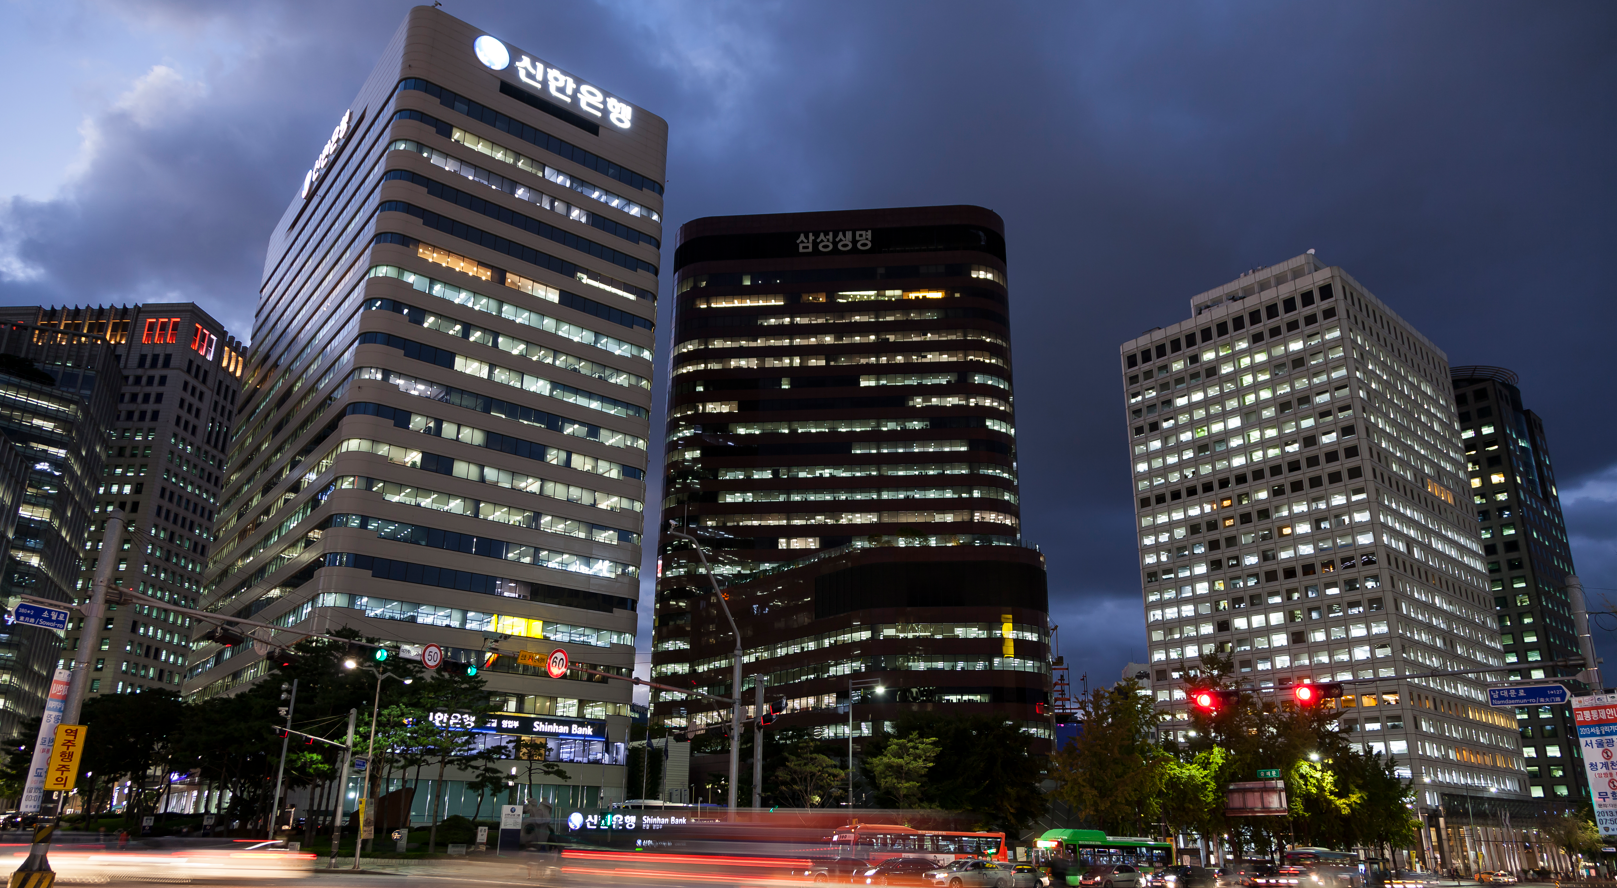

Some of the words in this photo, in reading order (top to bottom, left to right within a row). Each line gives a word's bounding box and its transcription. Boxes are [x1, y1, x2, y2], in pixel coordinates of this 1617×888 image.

[515, 55, 633, 129] 신한은행
[796, 229, 872, 252] 삼성생명
[41, 610, 65, 621] 소월로
[427, 650, 439, 663] 50
[551, 656, 565, 670] 60
[1490, 688, 1527, 699] 남대문로
[533, 721, 569, 734] Shinhan
[571, 724, 593, 736] Bank
[1584, 738, 1617, 749] 서울광
[53, 727, 79, 788] 역주행주의
[642, 815, 669, 825] Shinhan
[670, 817, 687, 825] Bank
